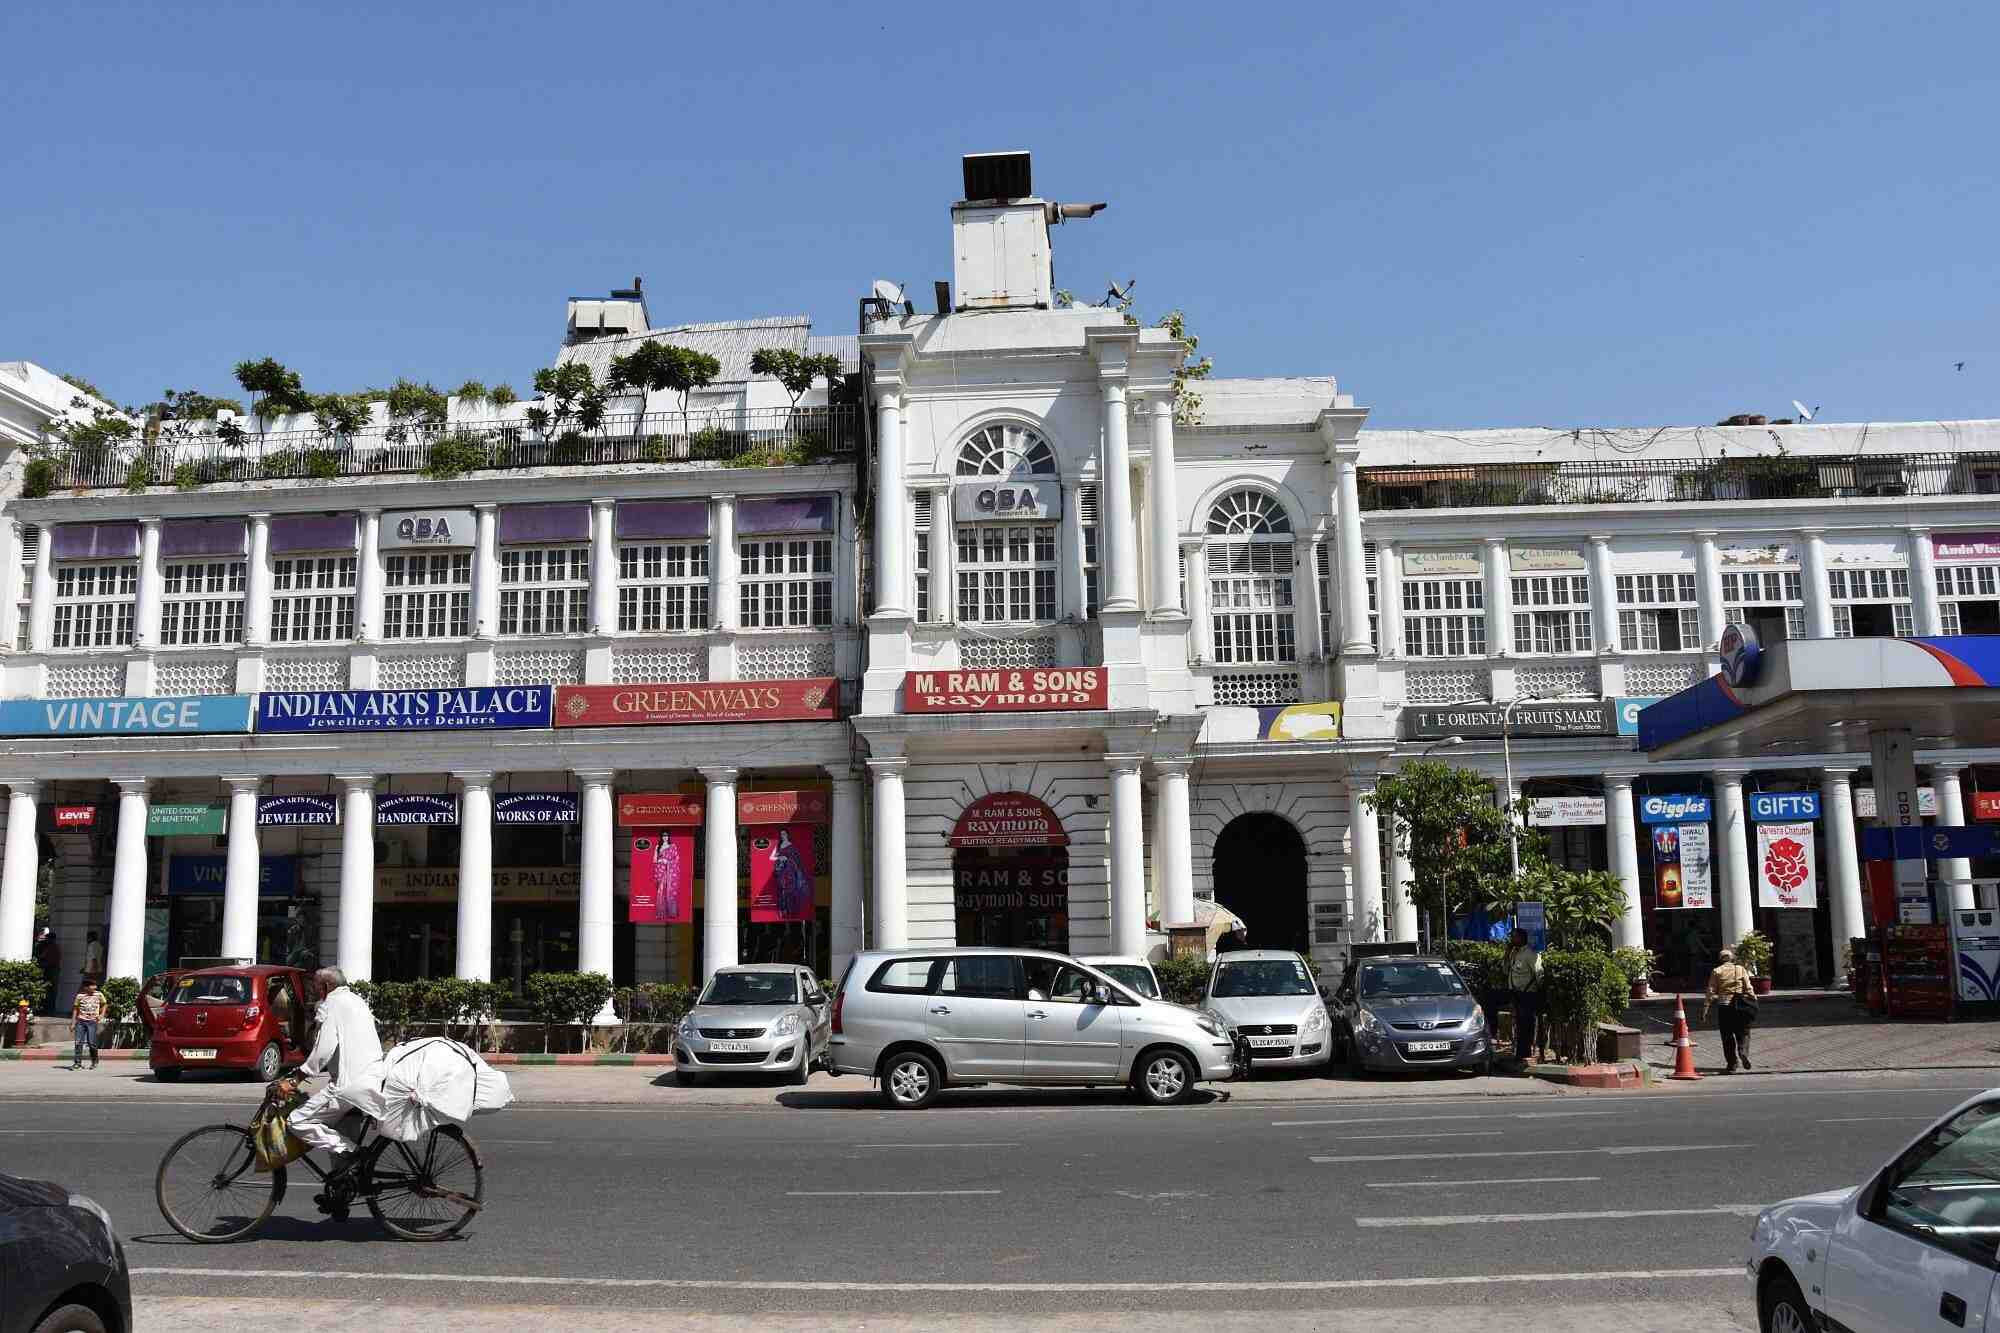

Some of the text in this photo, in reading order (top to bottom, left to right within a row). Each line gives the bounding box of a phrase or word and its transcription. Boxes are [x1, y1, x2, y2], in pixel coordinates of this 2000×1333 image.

[975, 488, 1037, 512] QBA
[398, 518, 452, 539] QBA
[915, 671, 1098, 693] M. RAM & SONS
[267, 689, 541, 717] INDIAN ARTS PALACE
[612, 688, 780, 713] GREENWAYS
[924, 691, 1090, 707] Raymond
[46, 701, 201, 730] VINTAGE
[308, 714, 495, 727] Jewellers & Art Dealers
[1517, 711, 1563, 725] FRUITS
[1565, 710, 1602, 723] MART
[259, 798, 285, 812] INDIAN
[306, 797, 333, 810] PALACE
[377, 797, 404, 811] INDIAN
[425, 796, 454, 811] PALACE
[496, 796, 523, 809] INDIAN
[755, 801, 807, 812] GREENWA
[1757, 796, 1815, 815] GIFTS
[151, 807, 208, 816] UNITED COLORS
[258, 812, 334, 824] JEWELLERY
[377, 812, 454, 823] HANDICRAFTS
[496, 810, 576, 822] WORKS OF ART
[984, 808, 1005, 817] RAM
[1006, 808, 1014, 817] &
[1016, 808, 1042, 817] SONS
[151, 815, 199, 824] OF BENETTON
[967, 818, 1049, 835] Raymond
[193, 865, 272, 881] VINE
[960, 870, 1009, 886] RAM
[1017, 870, 1032, 886] &
[1030, 894, 1067, 907] SUIT
